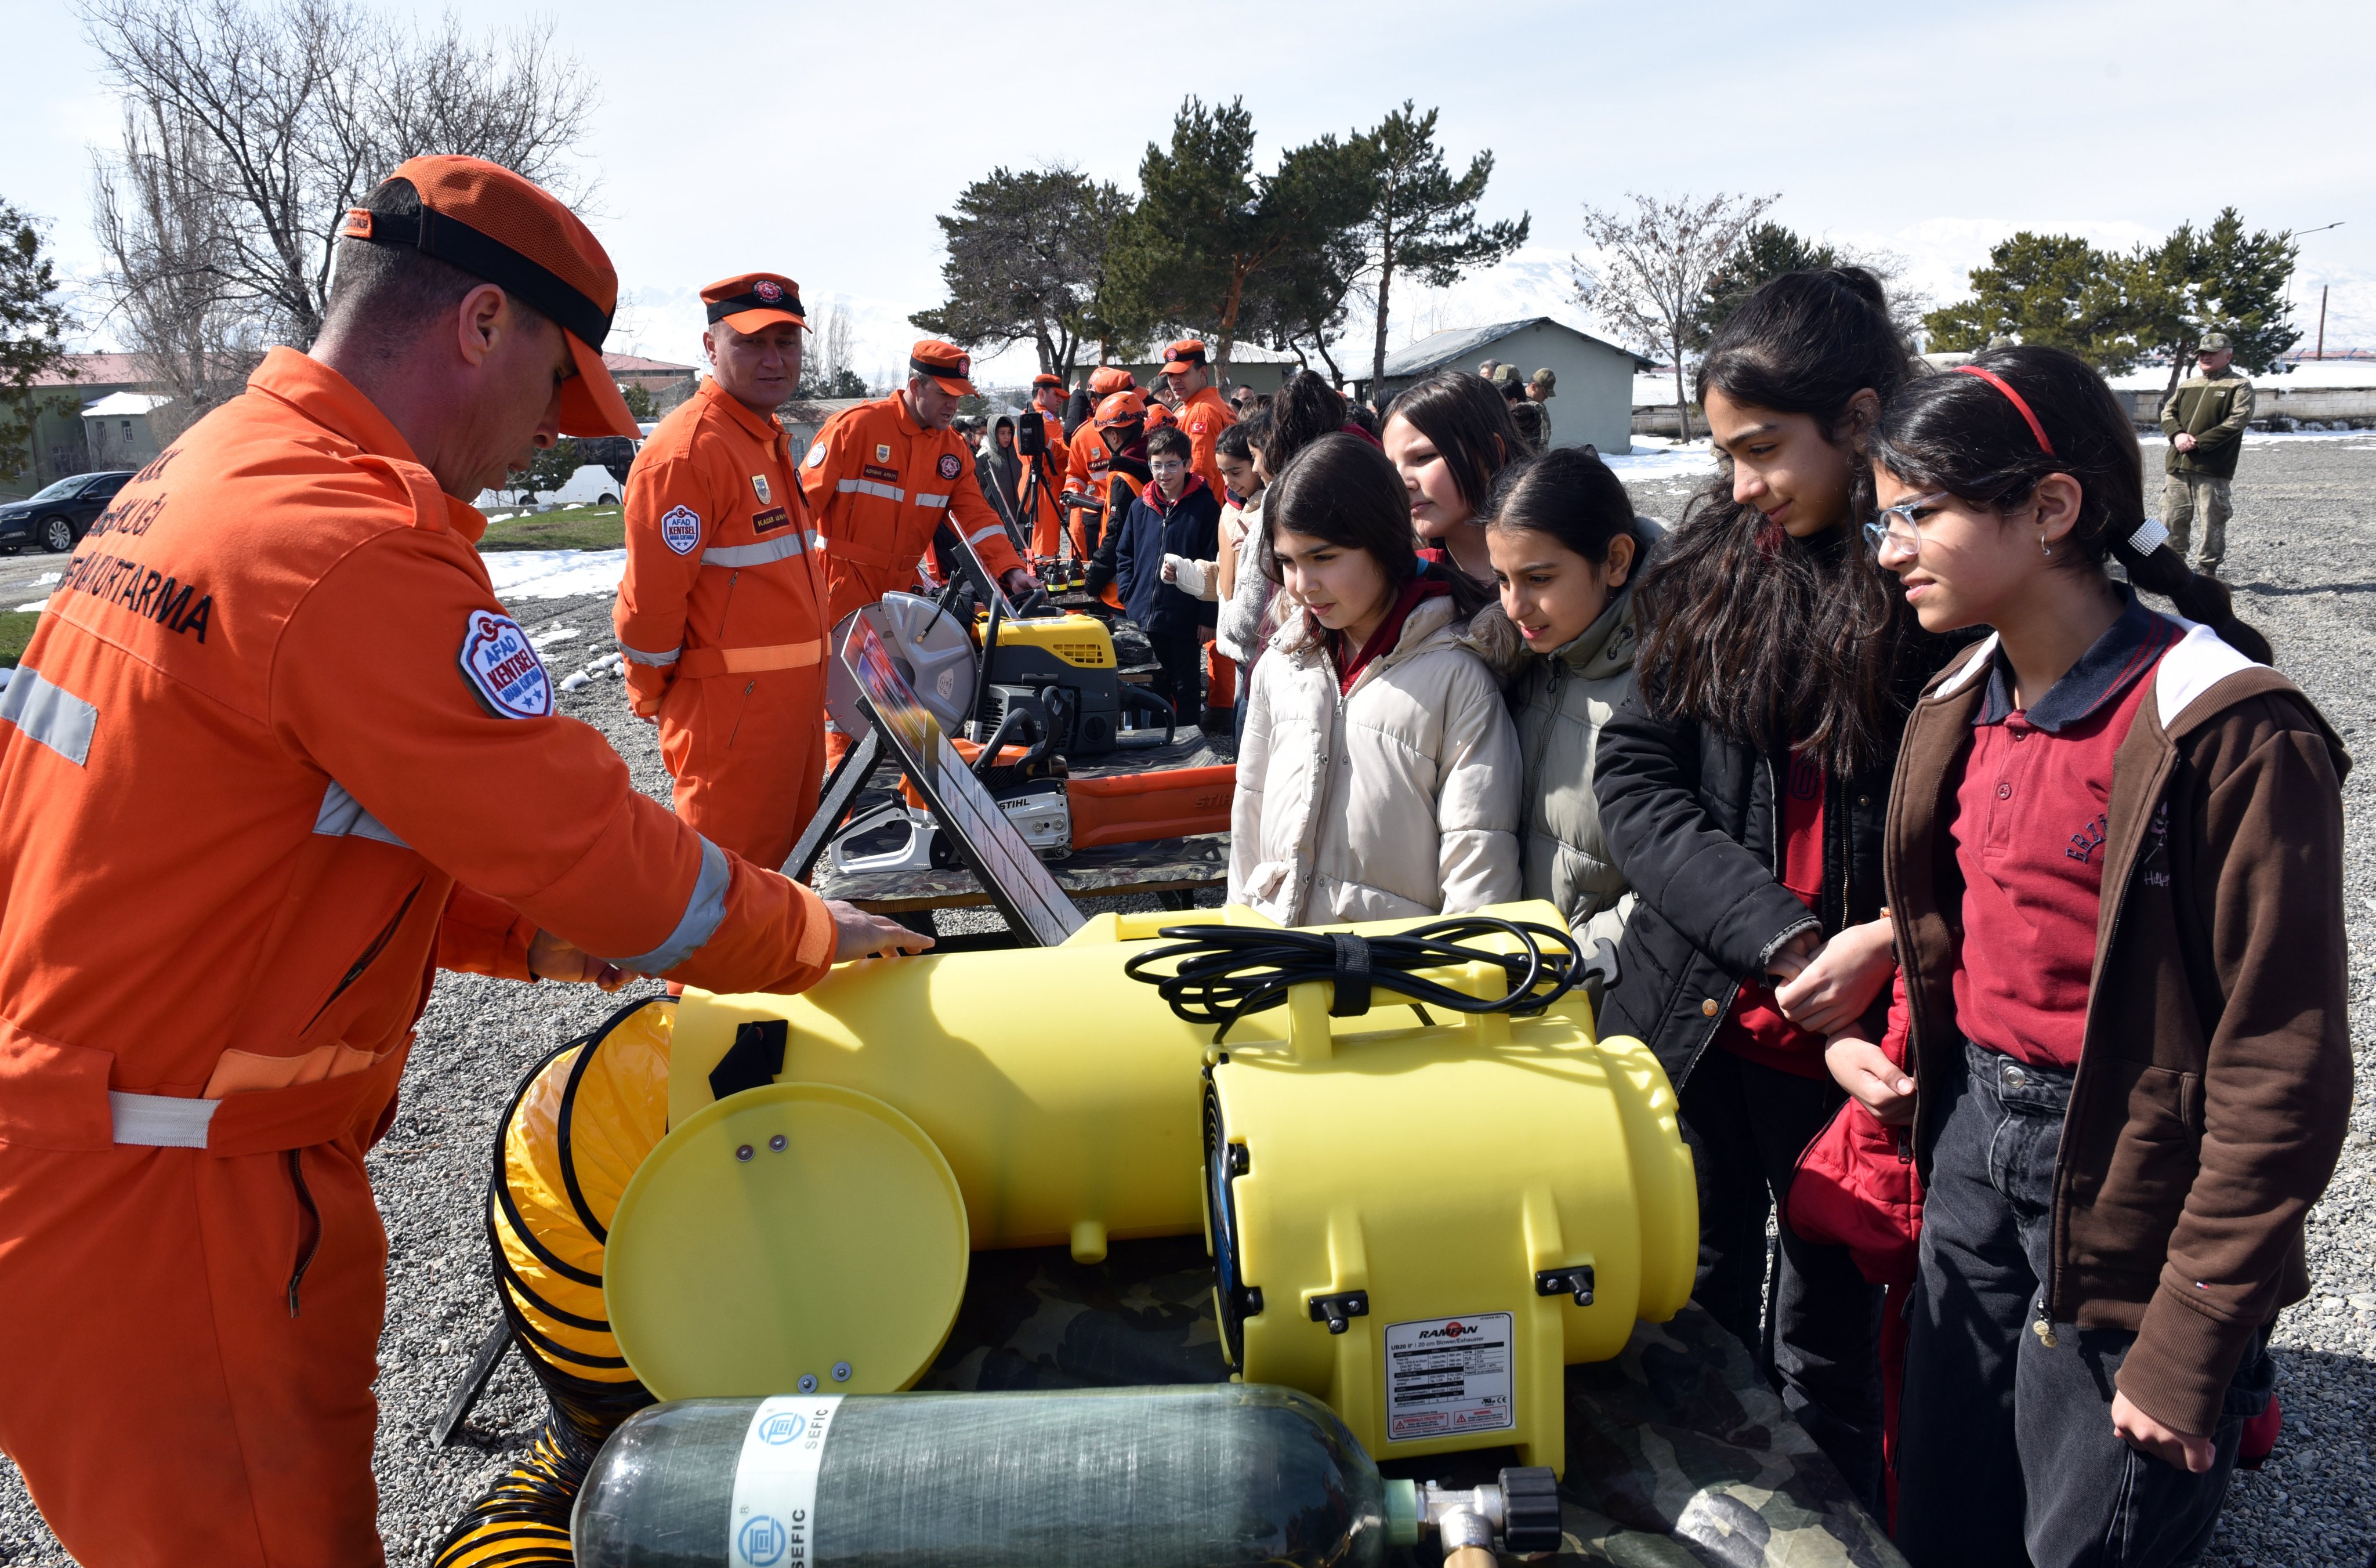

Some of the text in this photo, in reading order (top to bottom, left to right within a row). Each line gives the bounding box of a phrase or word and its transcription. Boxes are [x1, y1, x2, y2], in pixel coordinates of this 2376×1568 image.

[669, 526, 696, 535] KENTSEL
[484, 635, 517, 667] AFAD
[486, 648, 536, 692] KENTSEL
[999, 798, 1030, 810] STIHL
[1419, 1326, 1478, 1339] RAMFAN
[1436, 1337, 1484, 1345] Blower/Exhauster
[805, 1408, 828, 1450] SEFIC
